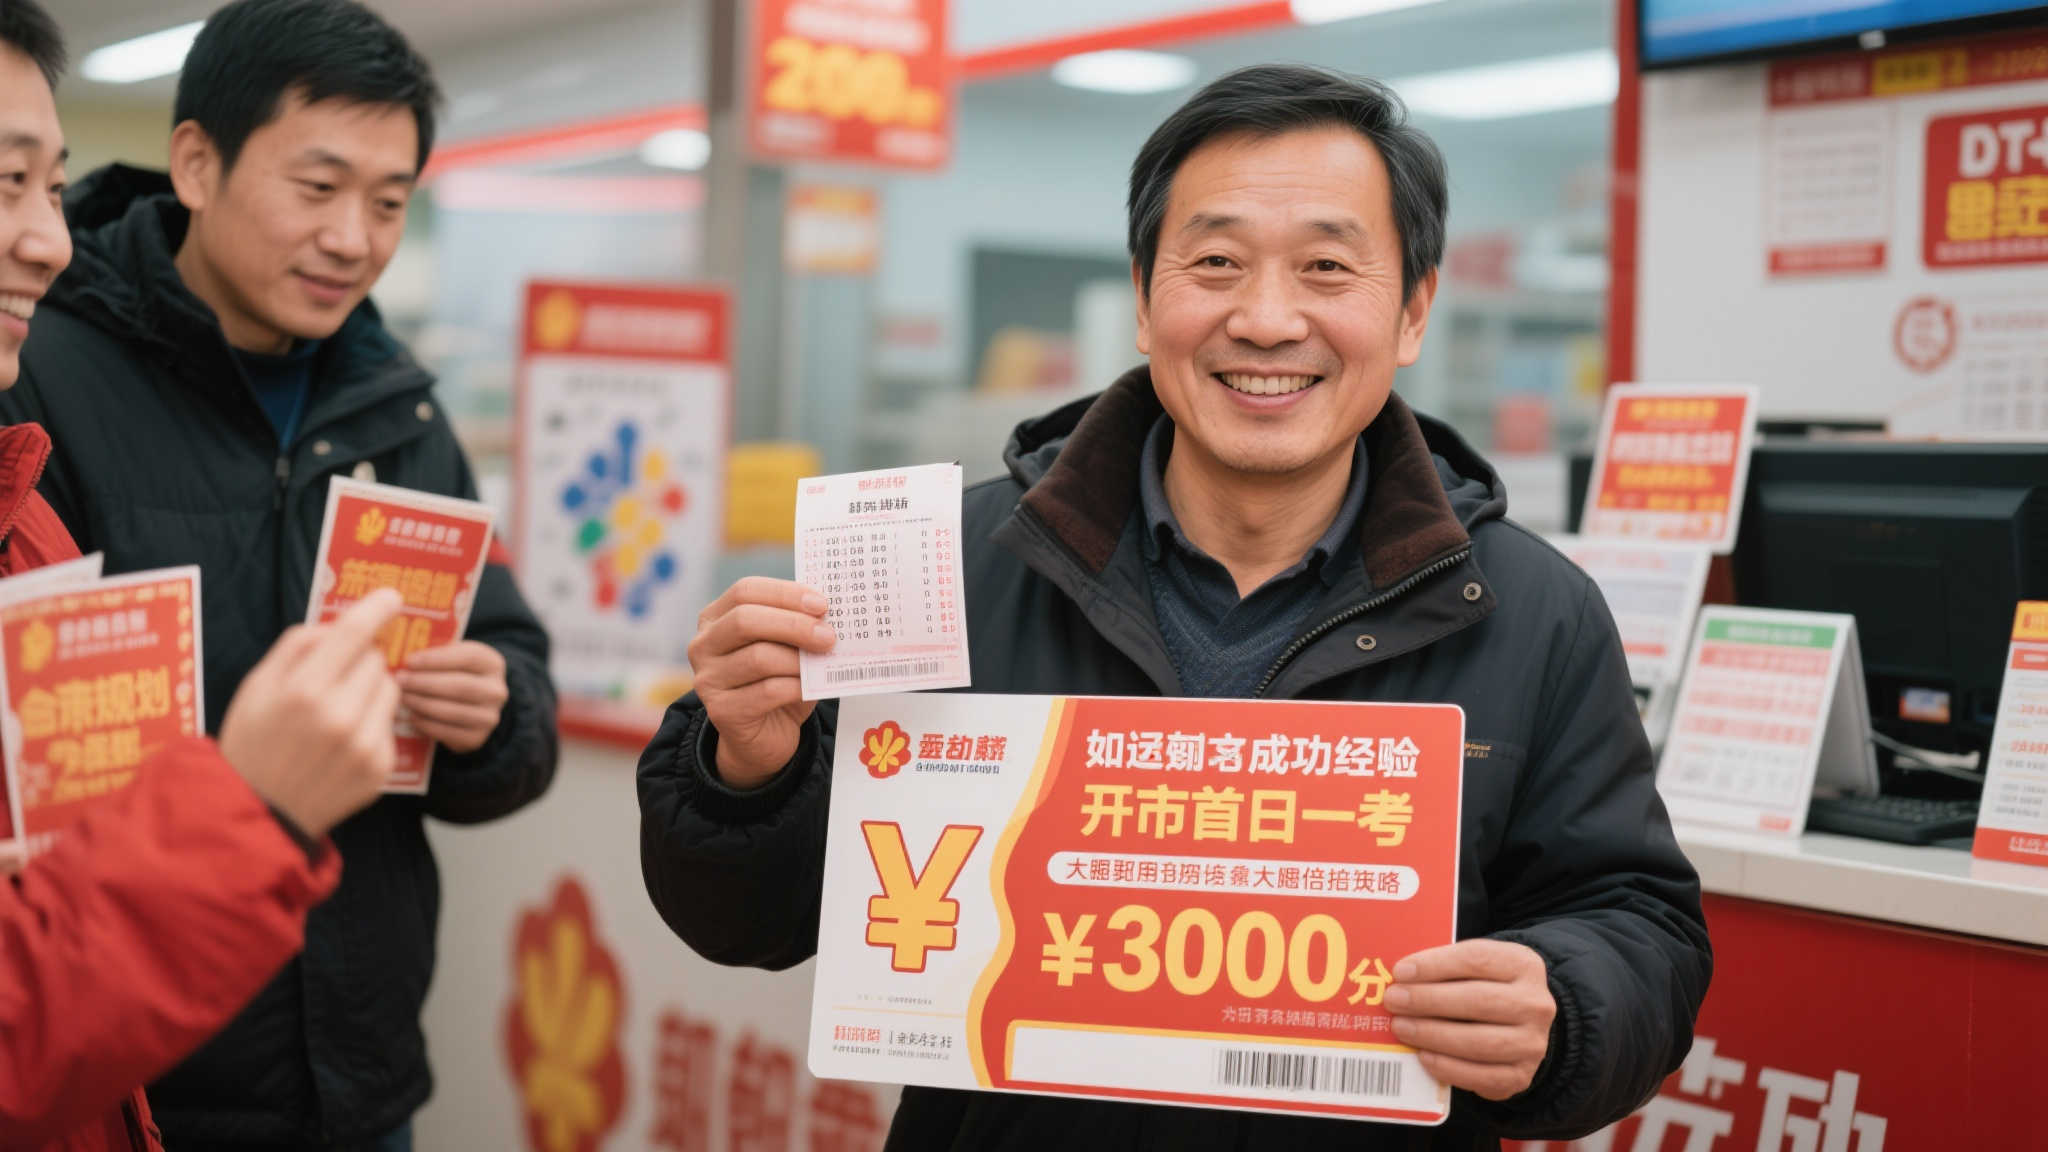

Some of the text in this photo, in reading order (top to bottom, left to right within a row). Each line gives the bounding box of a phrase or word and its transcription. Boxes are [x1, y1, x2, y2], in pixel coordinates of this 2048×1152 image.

[1080, 784, 1414, 847] 开市首日一考
